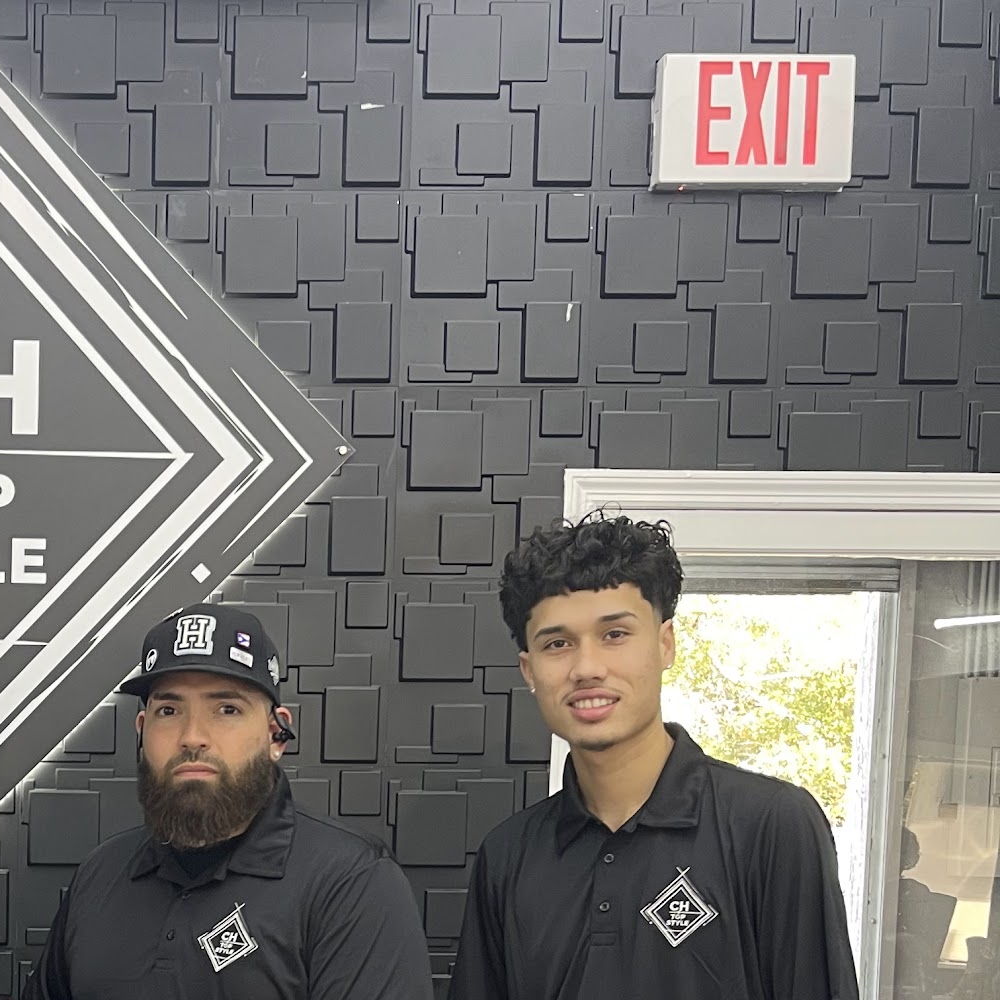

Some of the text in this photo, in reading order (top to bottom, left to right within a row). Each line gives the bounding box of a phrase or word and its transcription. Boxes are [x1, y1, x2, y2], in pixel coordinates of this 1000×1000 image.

[695, 61, 830, 165] EXIT
[176, 616, 213, 653] H
[669, 901, 690, 912] CH
[221, 931, 238, 943] CH
